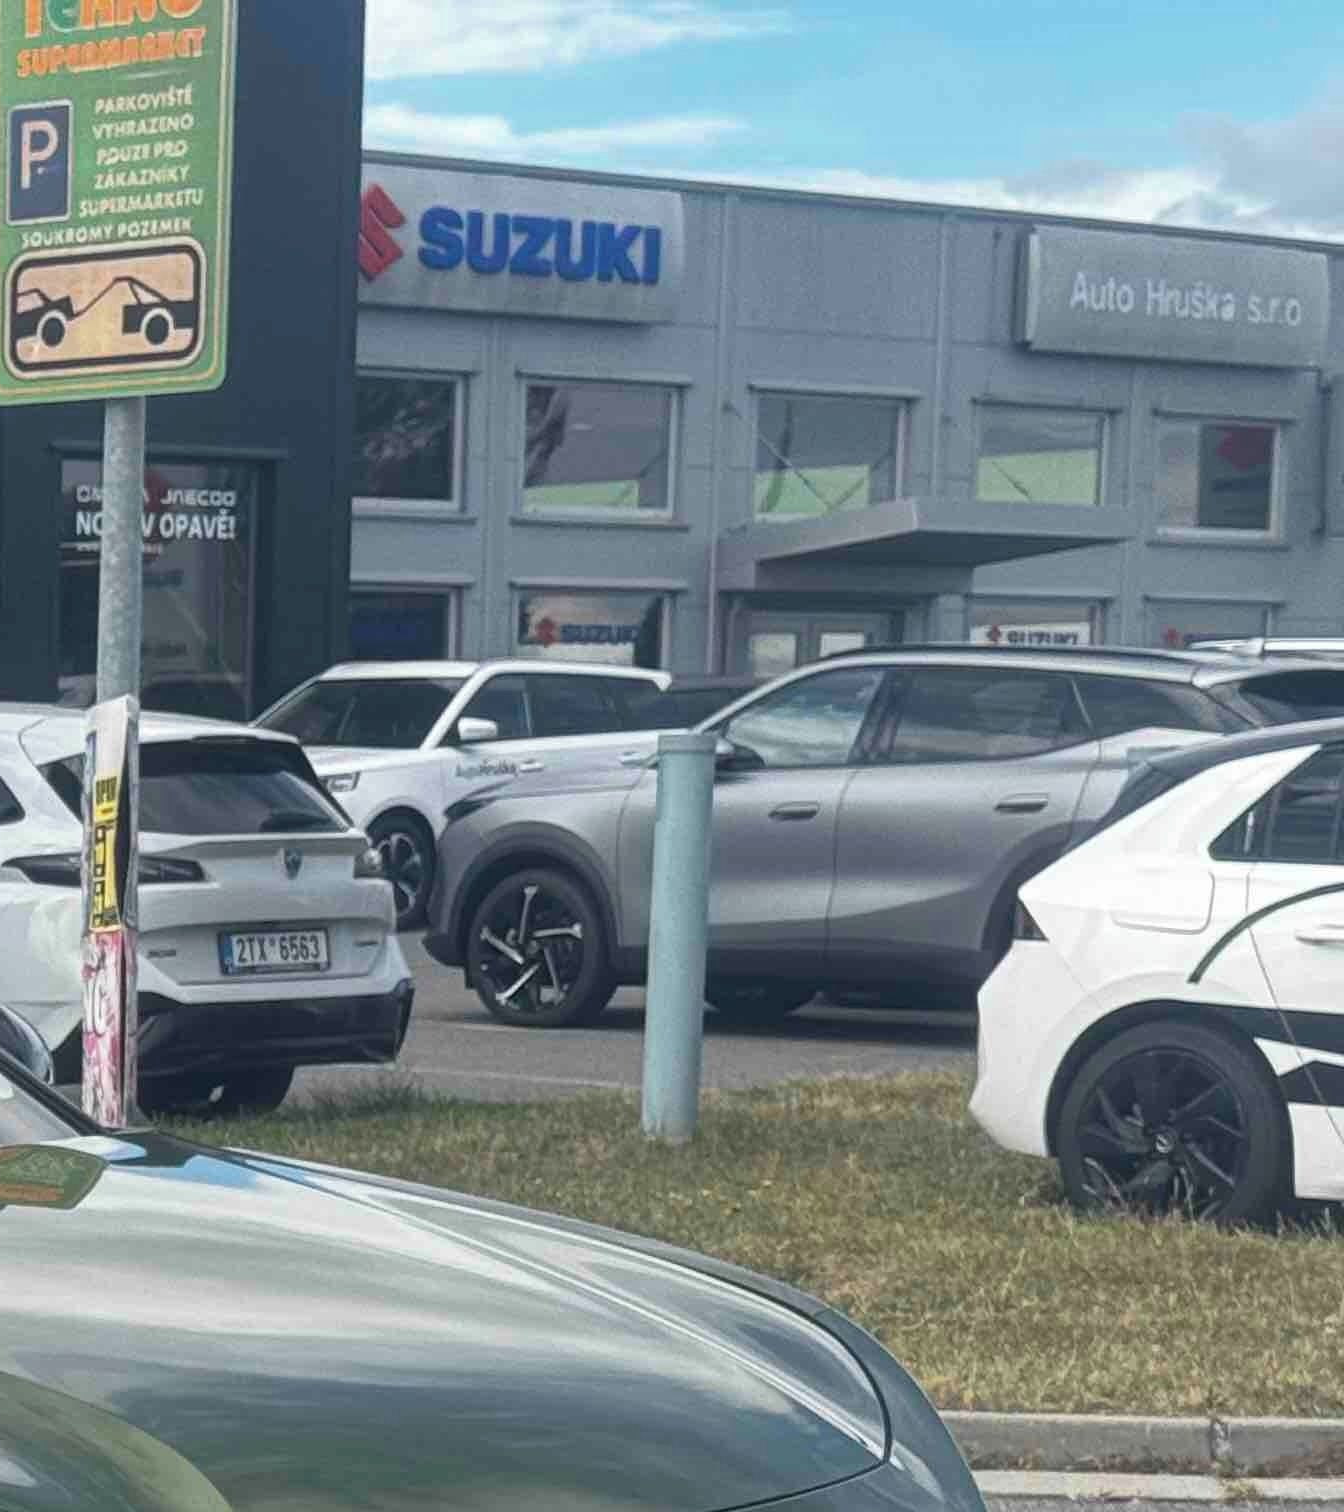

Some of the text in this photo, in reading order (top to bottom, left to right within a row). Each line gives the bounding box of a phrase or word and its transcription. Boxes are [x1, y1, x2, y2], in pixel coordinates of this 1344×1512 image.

[20, 119, 59, 189] P
[417, 205, 662, 286] SUZUKI
[1069, 271, 1134, 313] Auto
[235, 939, 266, 963] 2TX
